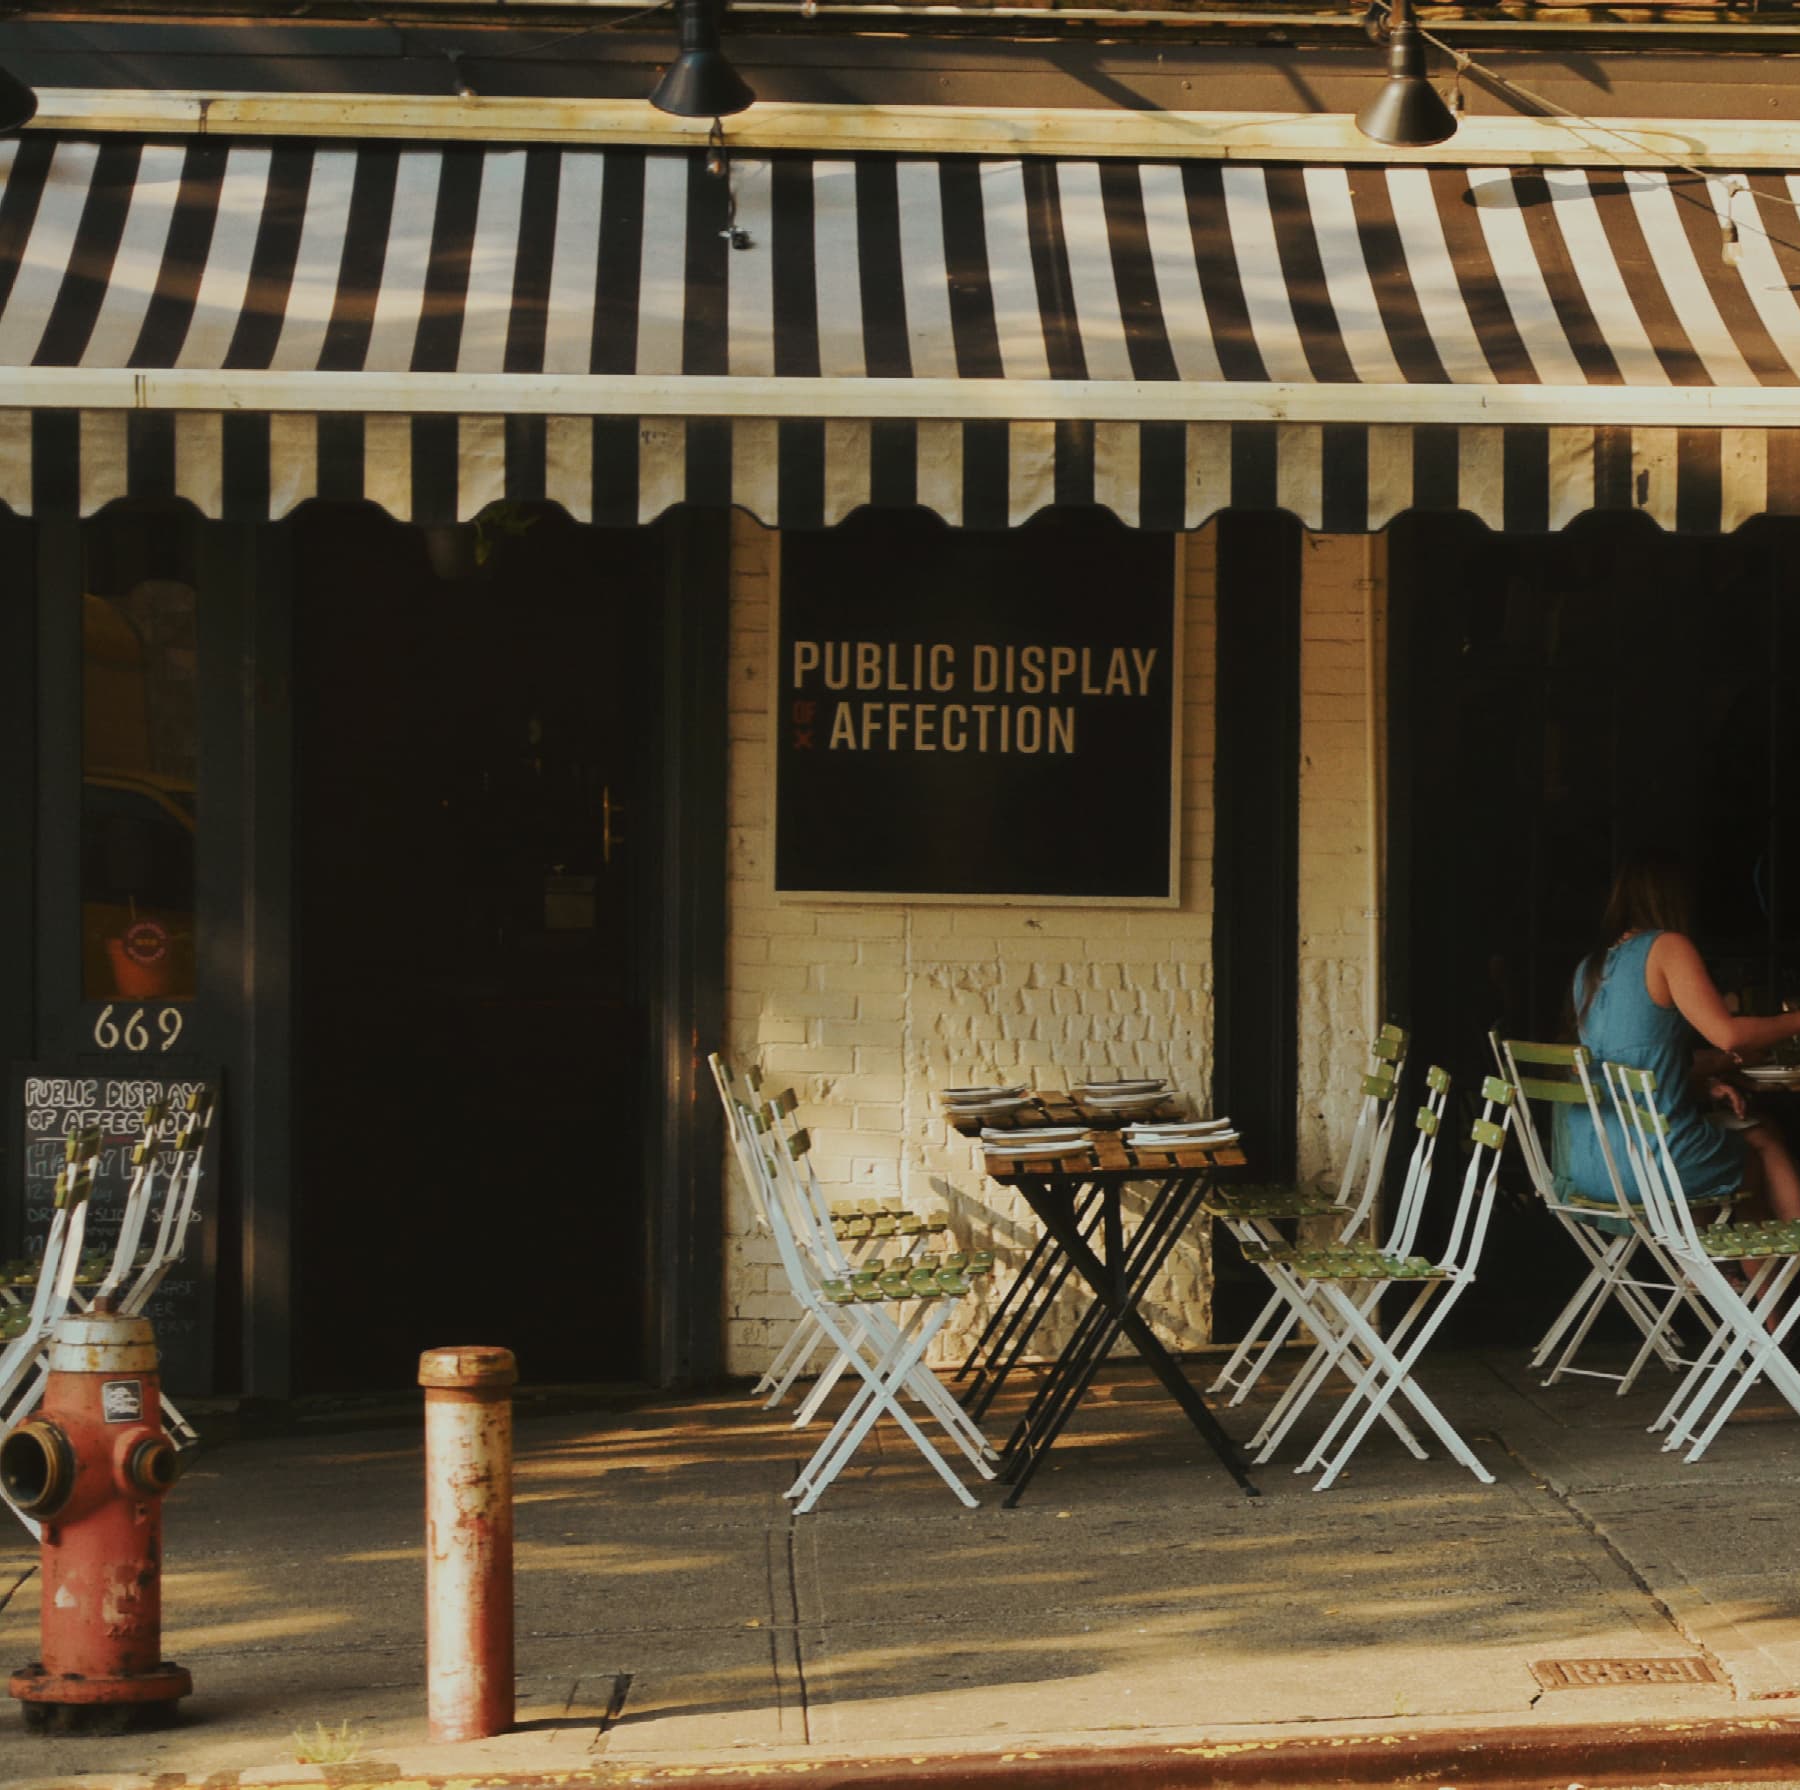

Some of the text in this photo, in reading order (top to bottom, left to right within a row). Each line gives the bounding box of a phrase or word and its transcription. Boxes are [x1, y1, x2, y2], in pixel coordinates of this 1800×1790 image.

[793, 641, 1158, 697] PUBLIC DISPLAY
[829, 701, 1077, 754] AFFECTION
[94, 1004, 184, 1051] 669
[25, 1078, 97, 1108] PUBLIC
[27, 1109, 57, 1131] OF
